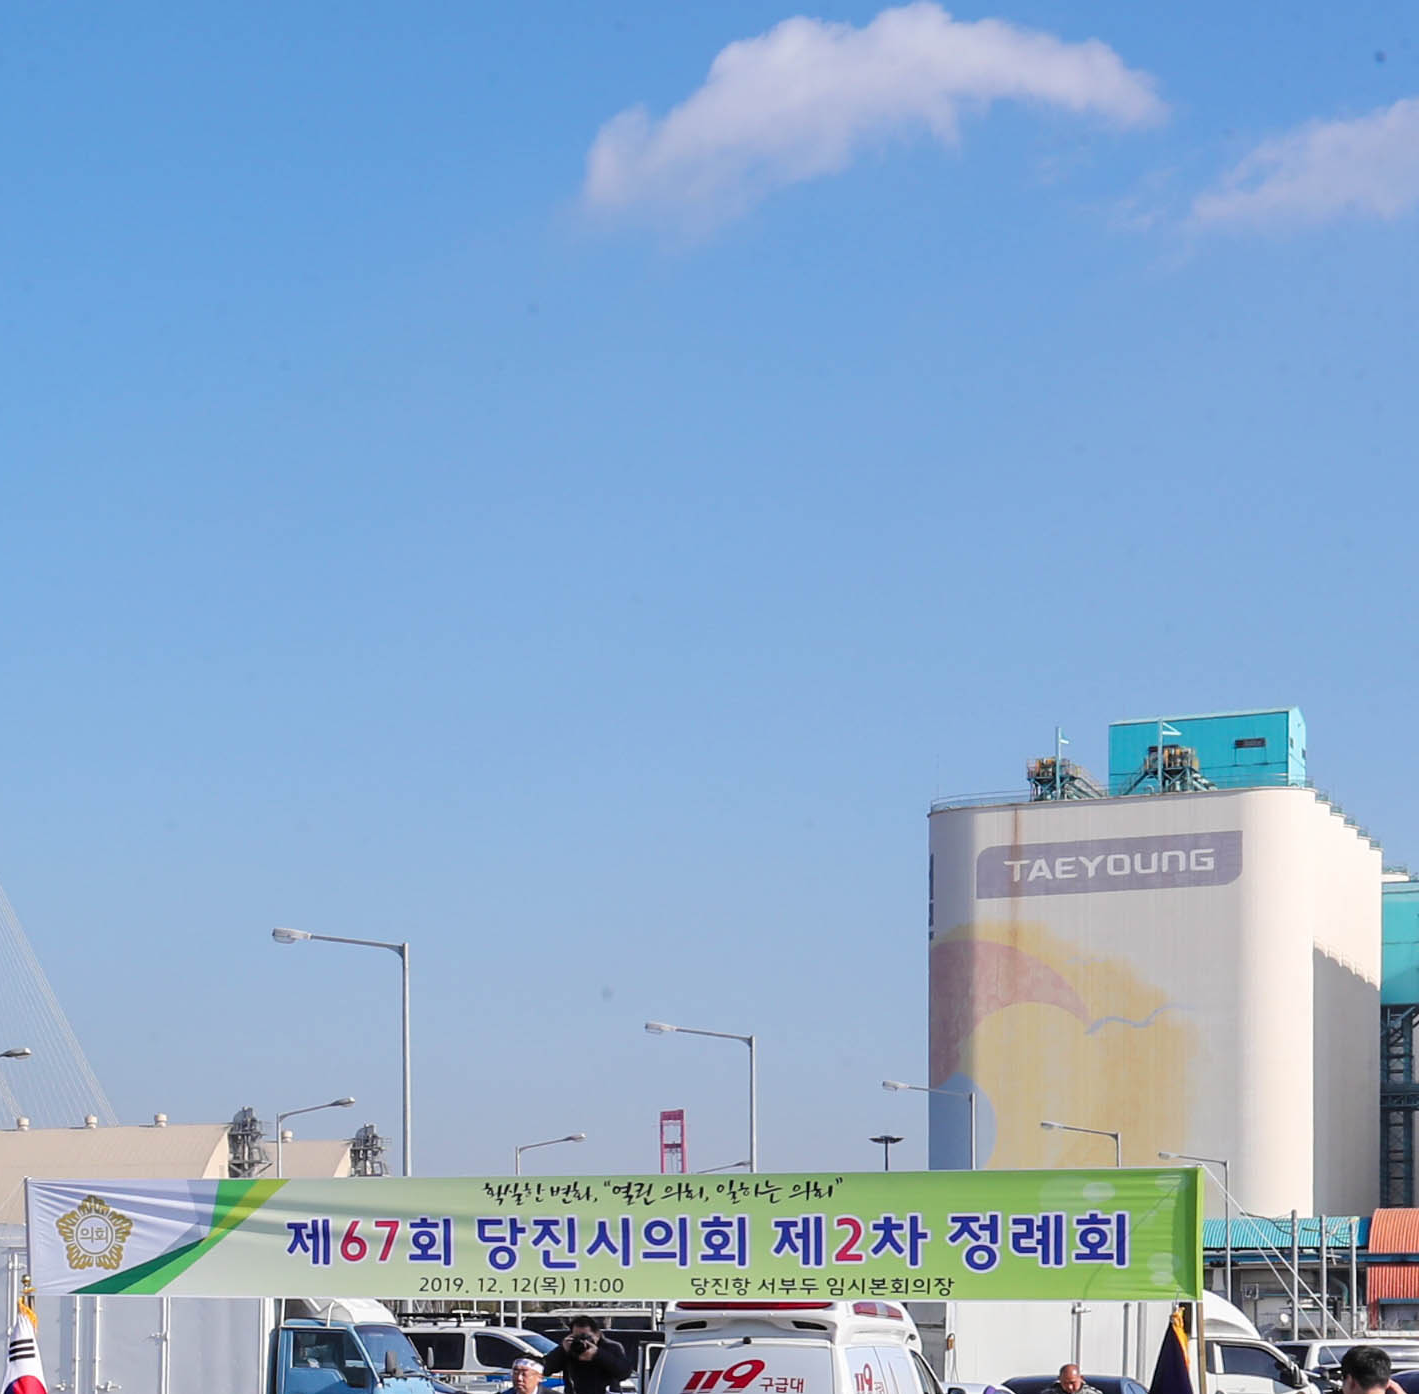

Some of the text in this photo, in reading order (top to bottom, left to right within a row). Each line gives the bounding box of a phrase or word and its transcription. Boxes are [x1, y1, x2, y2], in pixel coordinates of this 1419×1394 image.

[1004, 848, 1216, 882] TAEYOUNG
[715, 1181, 782, 1204] 일하는
[79, 1224, 112, 1245] 의회
[286, 1210, 1130, 1272] 제67회 당진시의회 제2차 정례회
[419, 1275, 625, 1296] 2019. 12. 12(목) 11:00
[690, 1275, 956, 1298] 당진항 서부두 임시본회의장
[679, 1359, 804, 1394] 119 구급대
